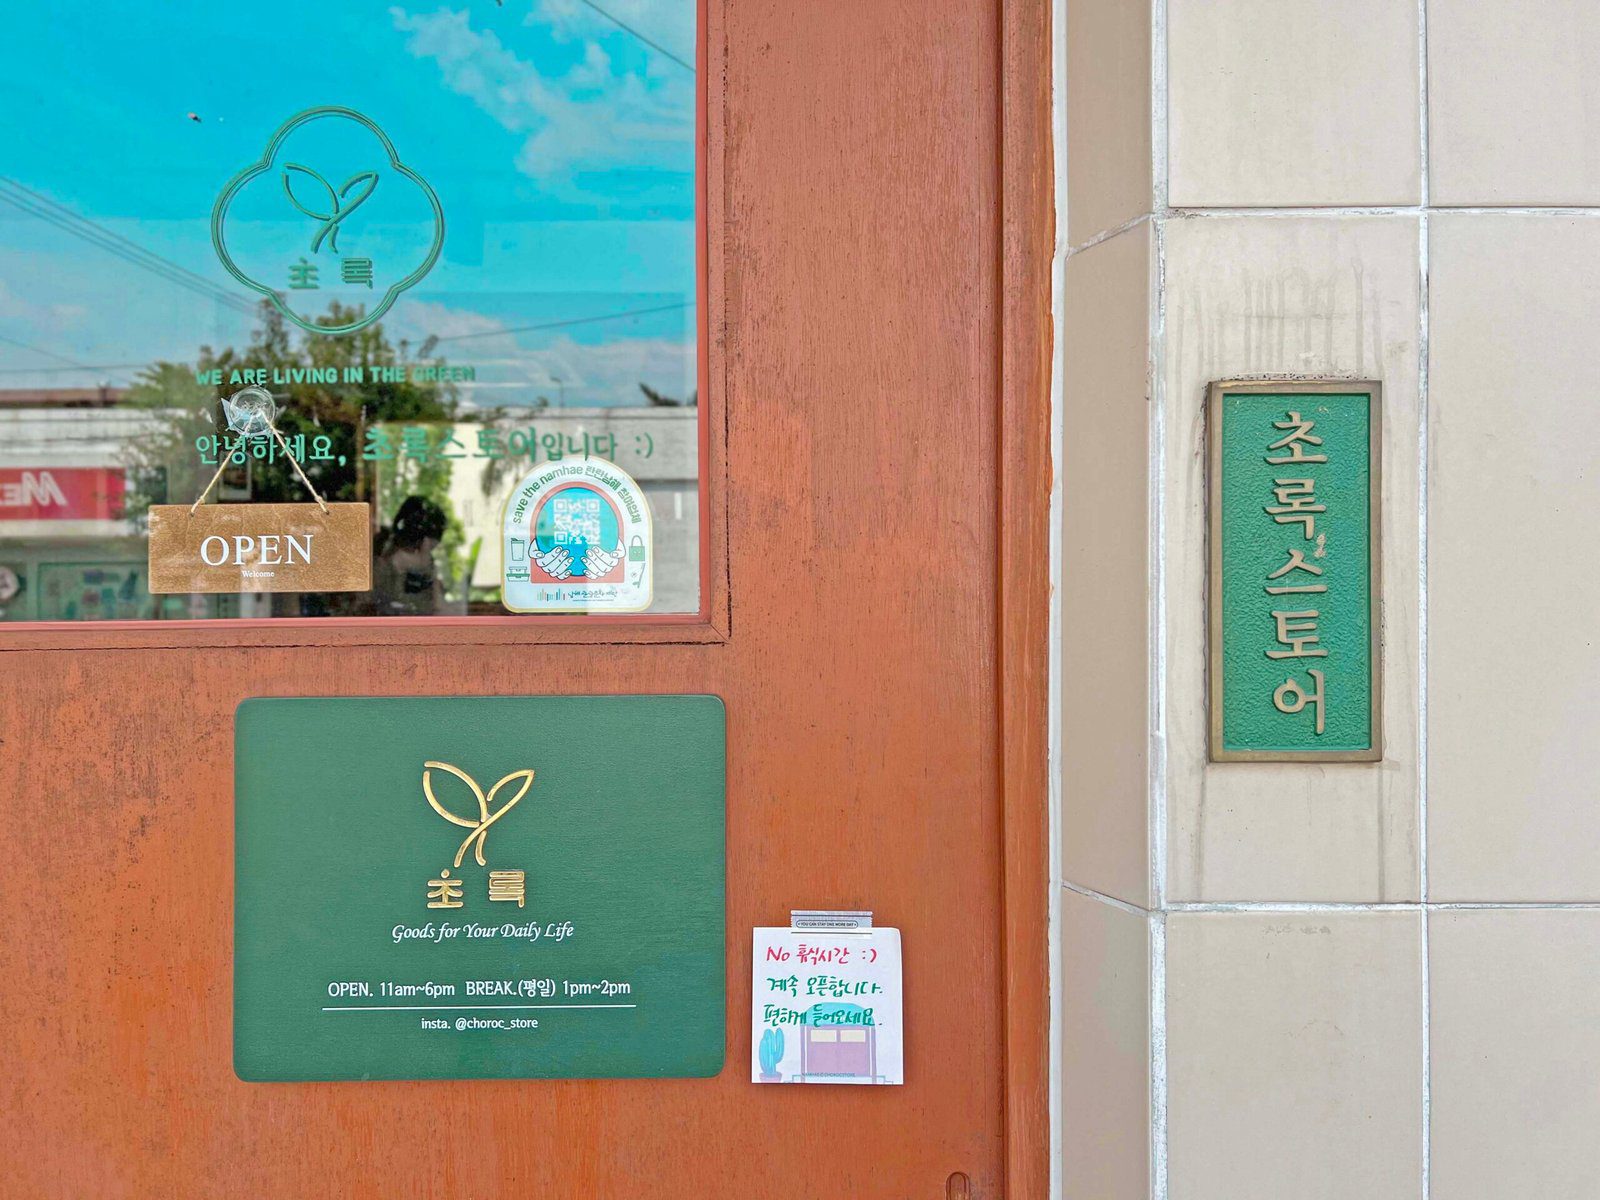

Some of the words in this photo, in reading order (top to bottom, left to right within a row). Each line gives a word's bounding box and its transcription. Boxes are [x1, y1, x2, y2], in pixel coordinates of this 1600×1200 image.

[195, 368, 222, 386] WE
[229, 368, 268, 385] ARE
[273, 367, 338, 384] LIVING
[343, 367, 364, 384] IN
[369, 366, 406, 383] THE
[411, 365, 477, 382] GREEN
[195, 433, 347, 467] 안녕하세요,
[362, 426, 618, 463] 초록스토어입니다
[512, 498, 529, 525] save
[524, 480, 541, 498] the
[540, 465, 584, 485] namhae
[200, 533, 315, 567] OPEN
[241, 570, 276, 579] Welcome
[1264, 410, 1329, 736] 초록스토어
[391, 923, 436, 944] Goods
[434, 923, 461, 943] for
[463, 922, 499, 939] Your
[500, 922, 541, 942] Daily
[543, 921, 575, 942] Life
[766, 946, 791, 962] No
[797, 944, 851, 966] 휴식시간
[327, 981, 374, 998] OPEN.
[380, 981, 456, 999] 11am~6pm
[562, 979, 631, 998] 1pm~2pm
[766, 974, 799, 998] 계속
[806, 975, 884, 997] 오픈합니다.
[421, 1017, 451, 1030] insta.
[455, 1016, 539, 1031] @choroc_store
[763, 1003, 807, 1027] 편하게
